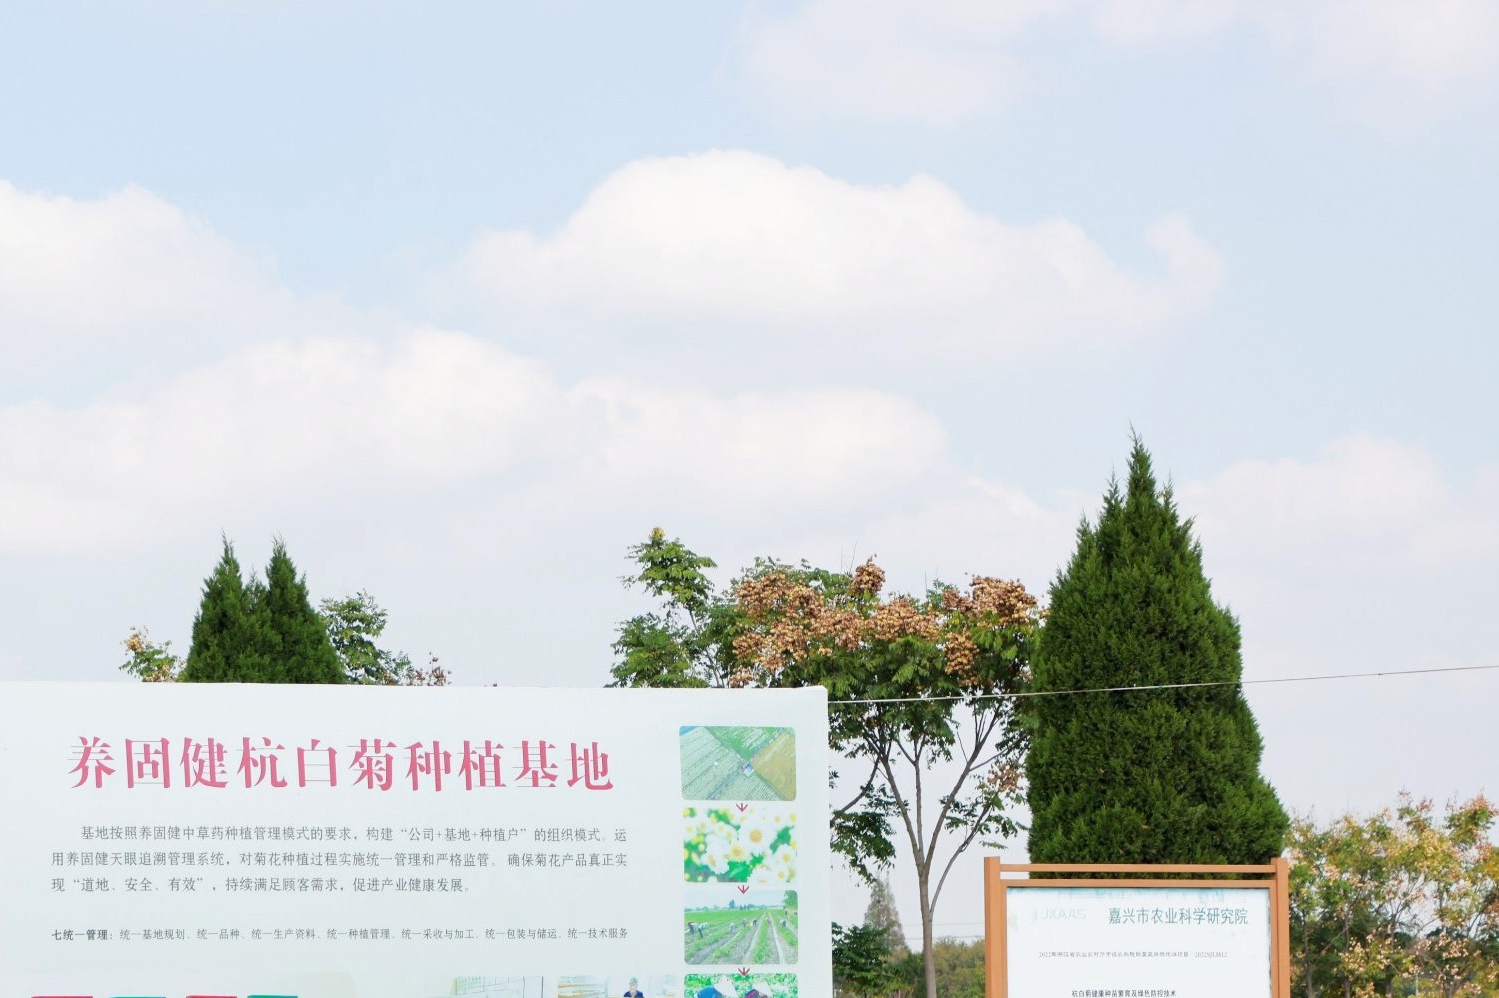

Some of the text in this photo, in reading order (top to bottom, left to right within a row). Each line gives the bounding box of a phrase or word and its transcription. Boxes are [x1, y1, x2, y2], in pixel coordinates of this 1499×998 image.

[68, 736, 614, 792] 养固健杭白菊种植基地
[1108, 907, 1249, 925] 嘉兴市农业科学研究院
